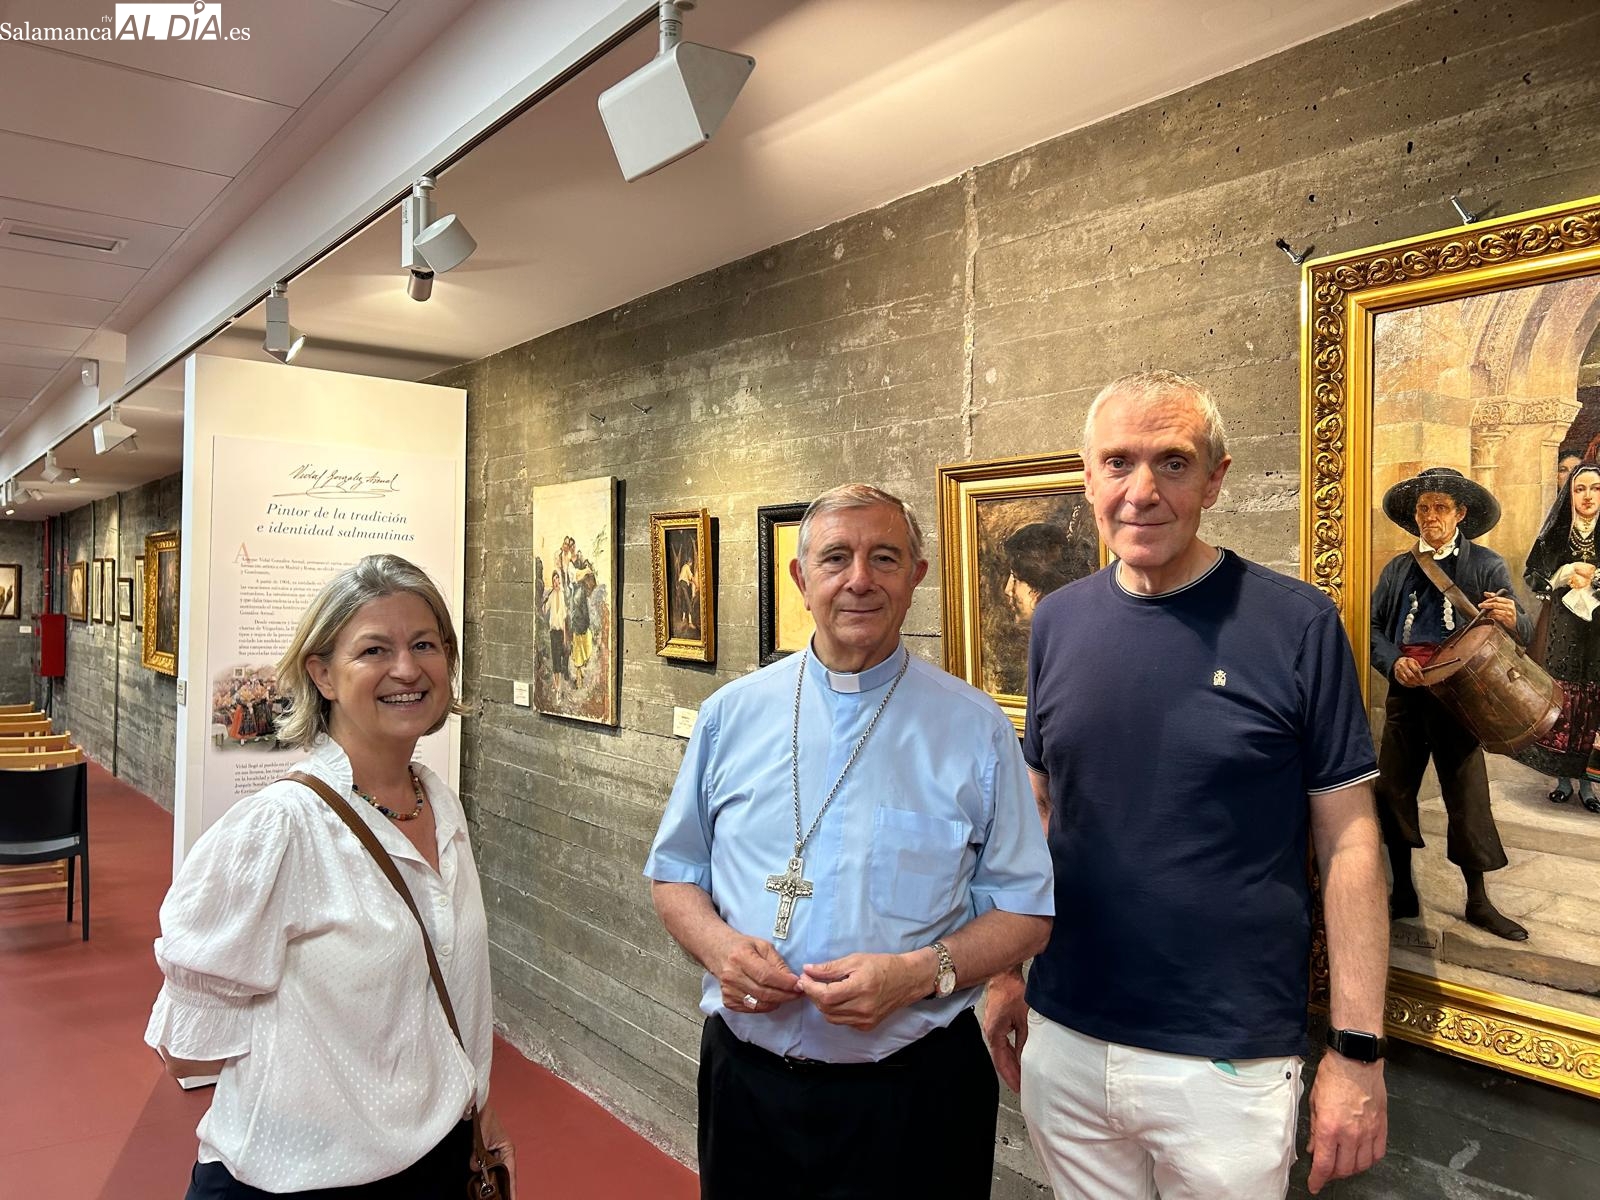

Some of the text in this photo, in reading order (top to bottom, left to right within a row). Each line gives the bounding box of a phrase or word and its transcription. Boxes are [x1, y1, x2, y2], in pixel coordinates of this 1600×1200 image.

[266, 502, 408, 525] Pintor de la tradición
[256, 521, 416, 542] e identidad salmantinas
